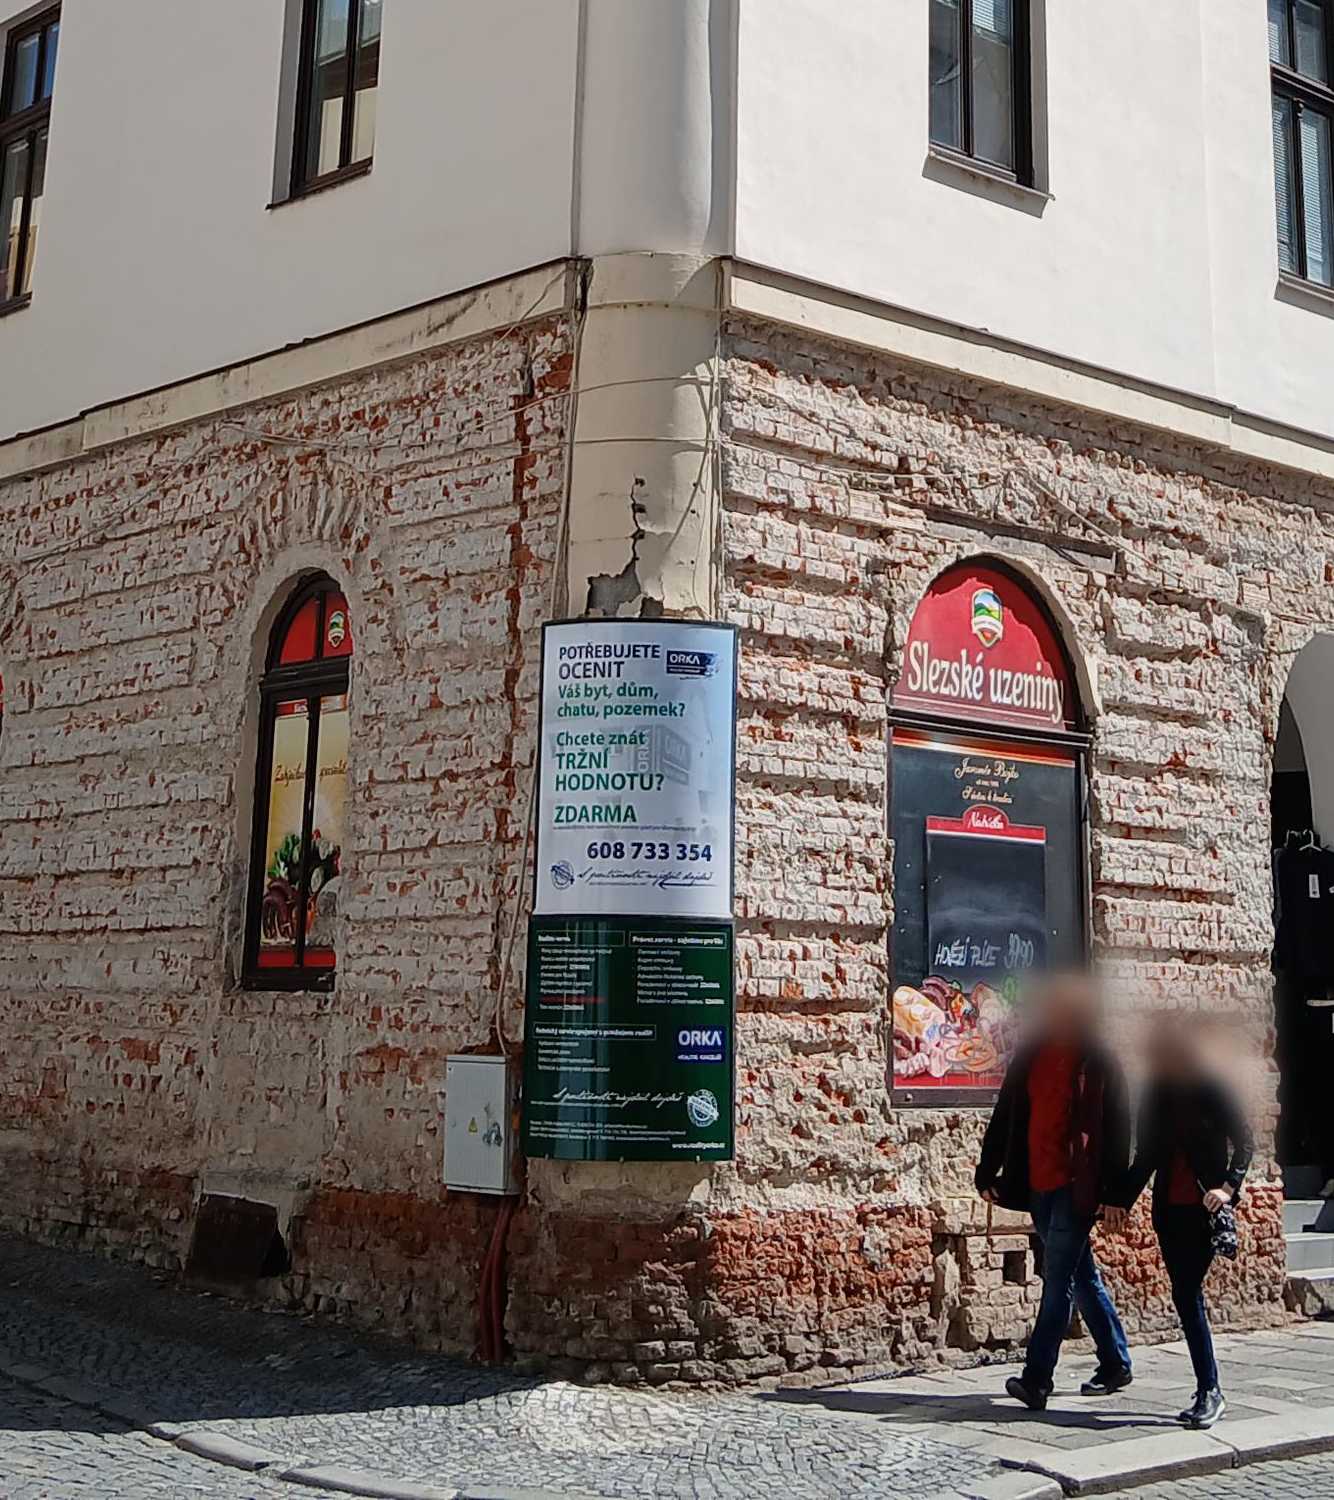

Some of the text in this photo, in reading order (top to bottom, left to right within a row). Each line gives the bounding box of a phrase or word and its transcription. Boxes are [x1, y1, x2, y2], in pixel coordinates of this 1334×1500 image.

[559, 642, 661, 660] POTŘEBUJETE
[669, 654, 700, 665] ORKA
[558, 661, 625, 679] OCENIT
[558, 681, 659, 701] Váš byt, dům,
[908, 641, 1064, 723] Slezské uzeniny
[557, 701, 686, 719] chatu, pozemek?
[556, 730, 645, 746] Chcete znát
[556, 747, 609, 769] TRŽNÍ
[555, 773, 665, 791] HODNOTU?
[554, 804, 637, 823] ZDARMA
[587, 842, 712, 861] 608 733 354
[678, 1030, 722, 1046] ORKA
